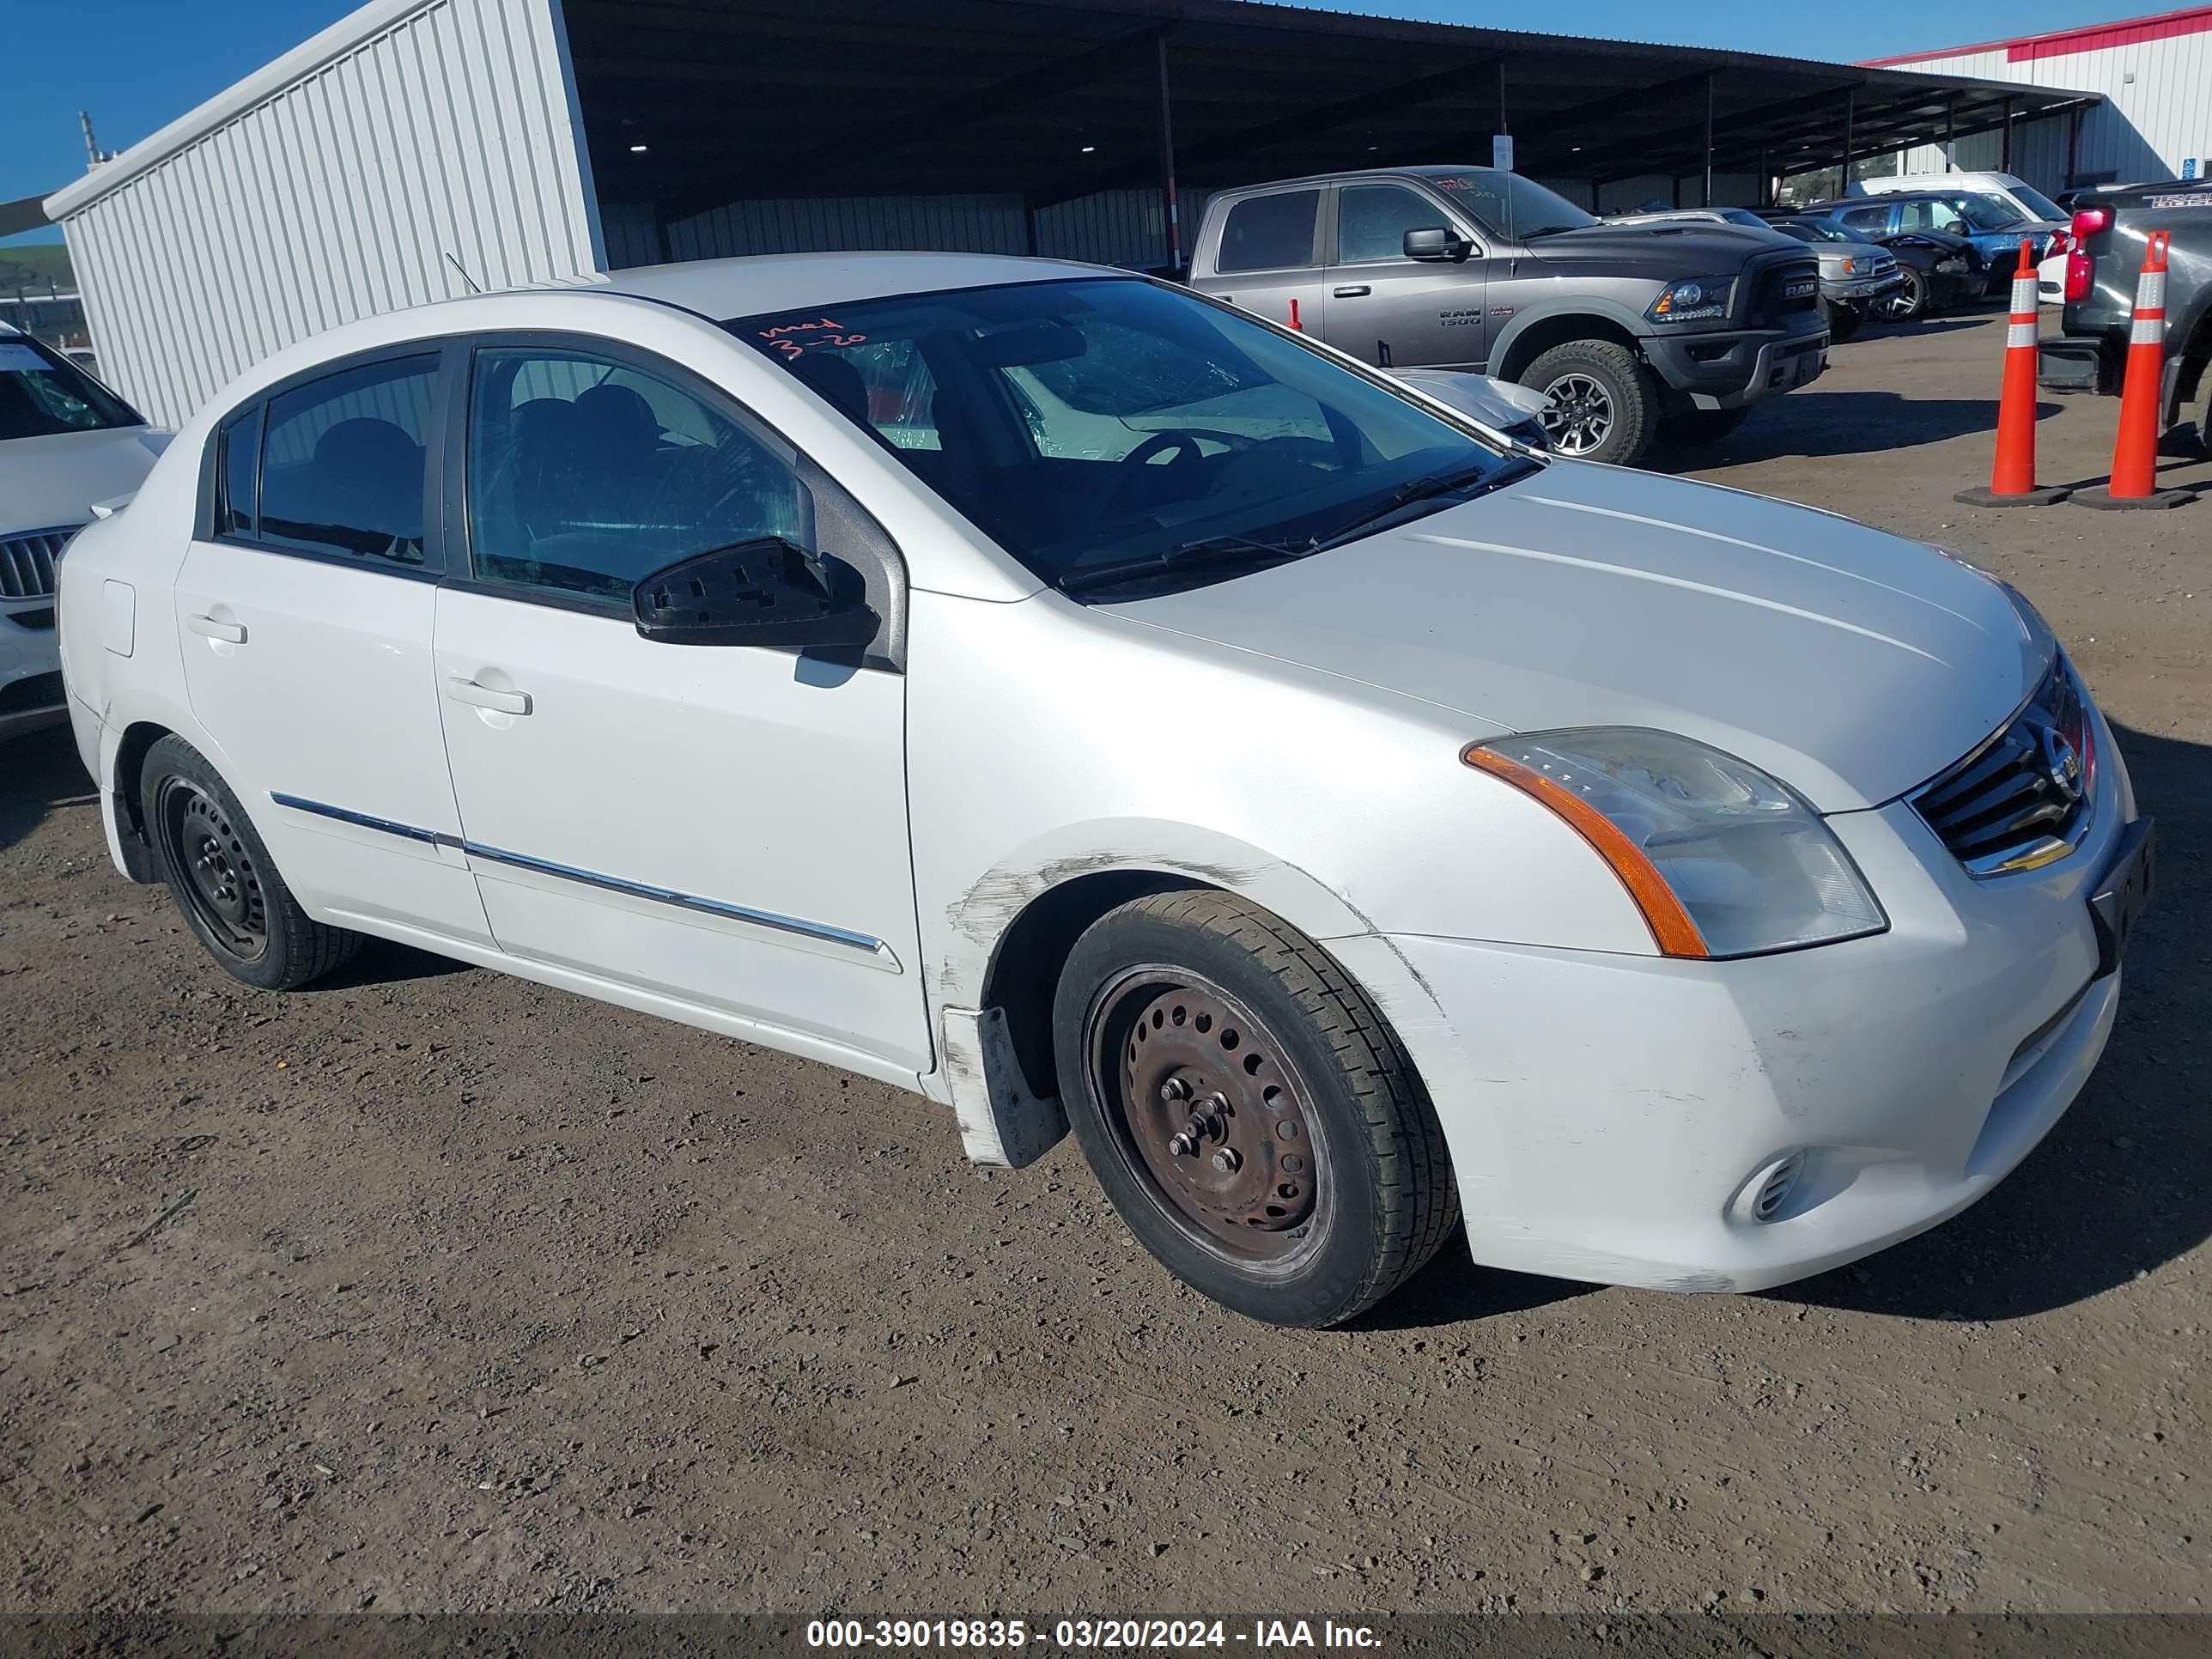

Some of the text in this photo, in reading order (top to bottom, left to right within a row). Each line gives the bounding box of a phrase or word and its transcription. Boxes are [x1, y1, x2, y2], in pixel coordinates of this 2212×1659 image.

[1786, 283, 1814, 296] RAM
[1439, 308, 1481, 318] RAM
[1439, 317, 1481, 326] 1500
